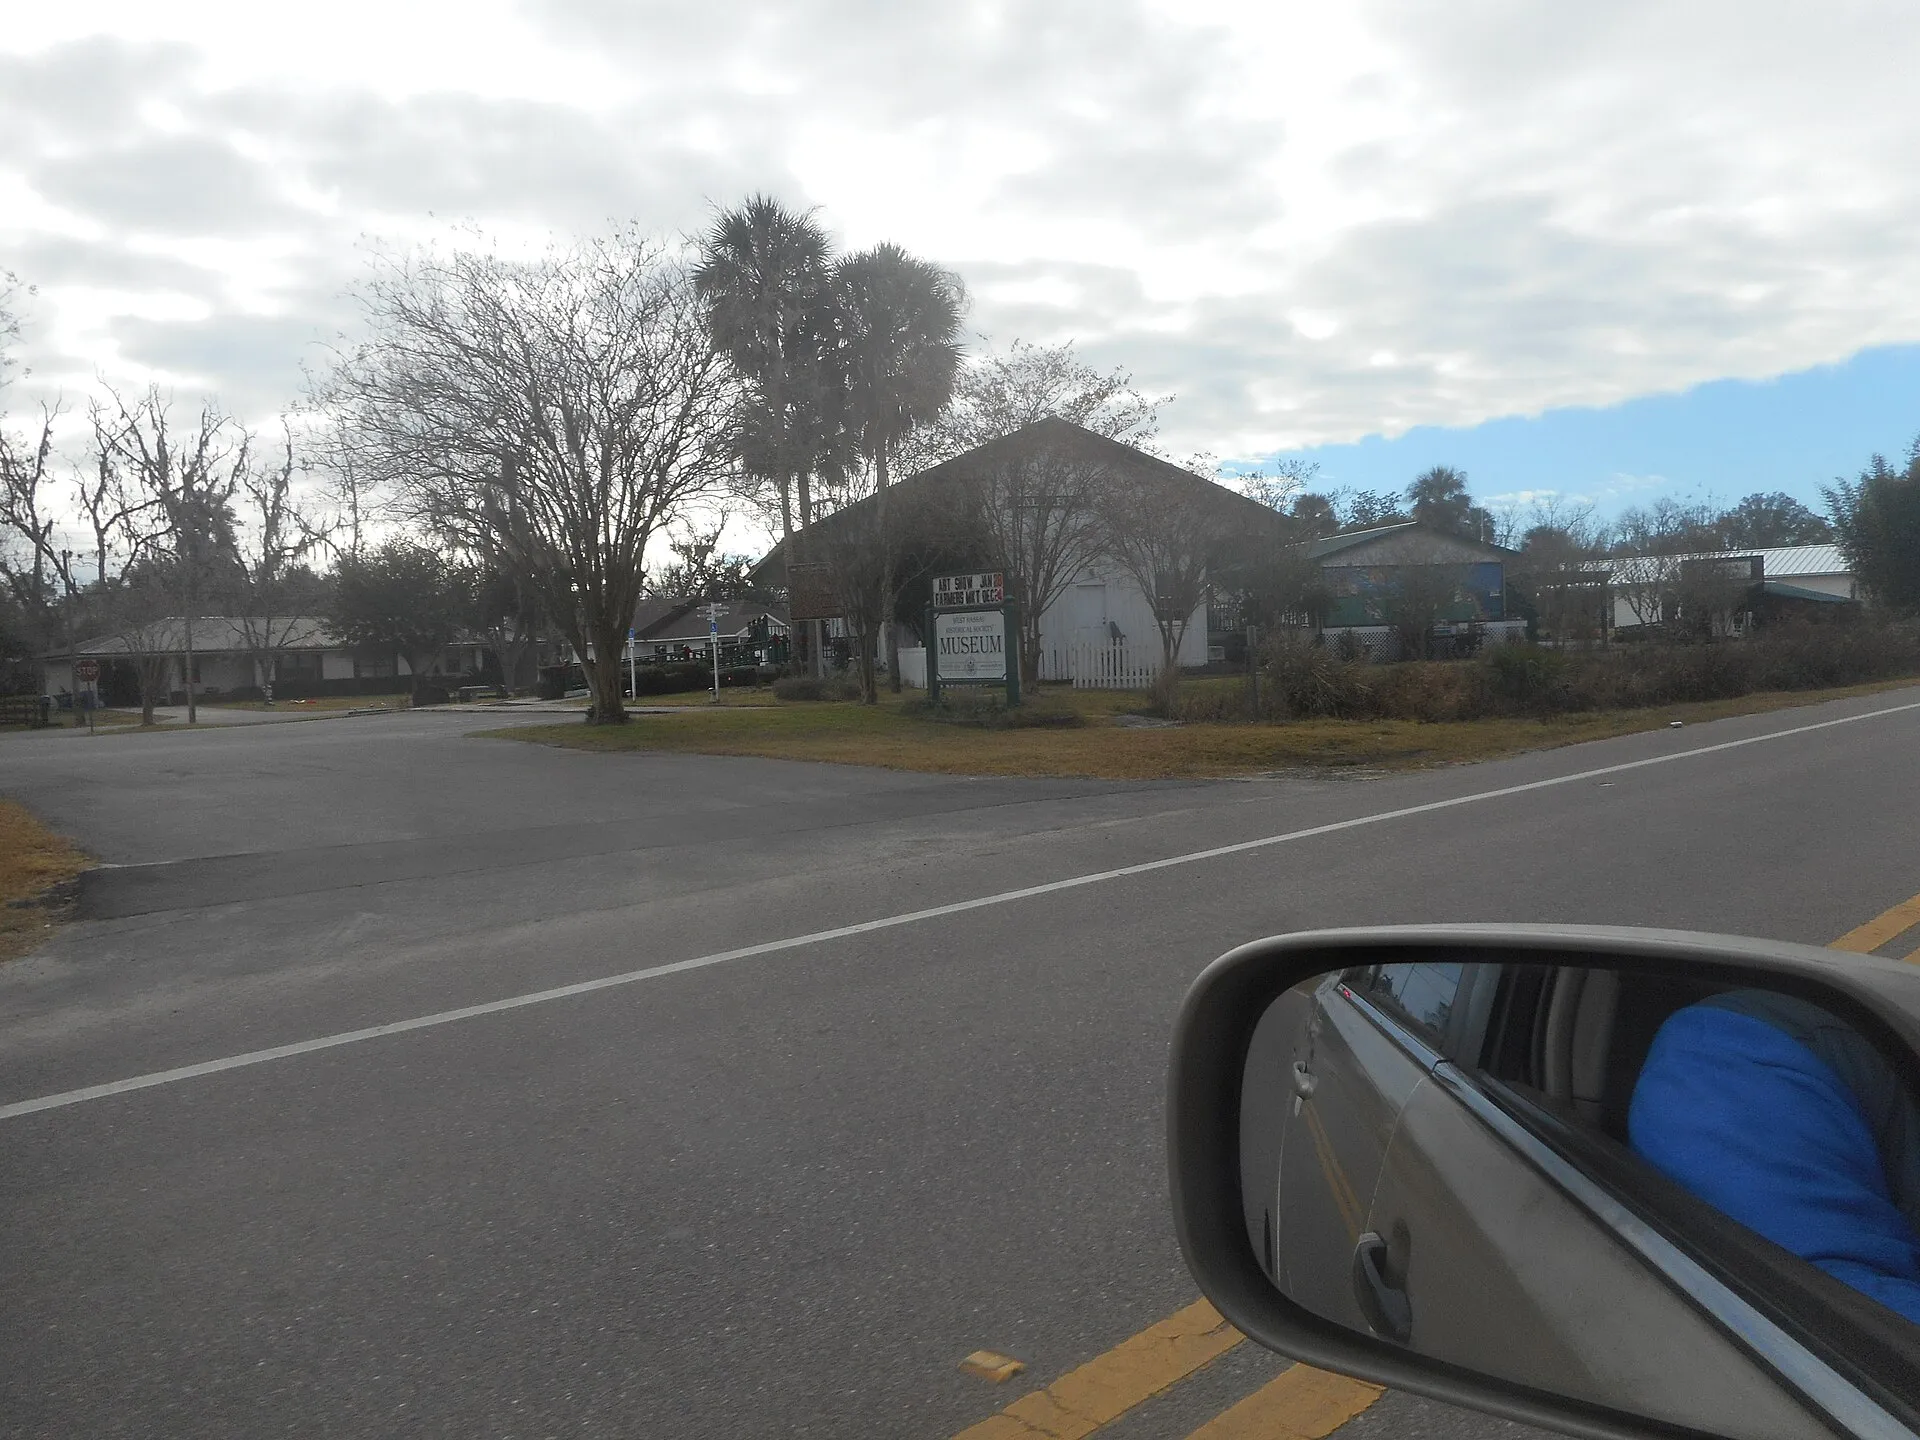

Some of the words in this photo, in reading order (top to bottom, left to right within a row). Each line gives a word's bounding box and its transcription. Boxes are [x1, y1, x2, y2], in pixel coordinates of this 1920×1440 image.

[938, 578, 951, 592] ART
[954, 576, 973, 590] SHOW
[980, 574, 993, 588] JAN
[935, 591, 964, 606] FARMERS
[982, 588, 994, 603] DEC
[940, 635, 1001, 655] MUSEUM
[76, 666, 98, 676] STOP
